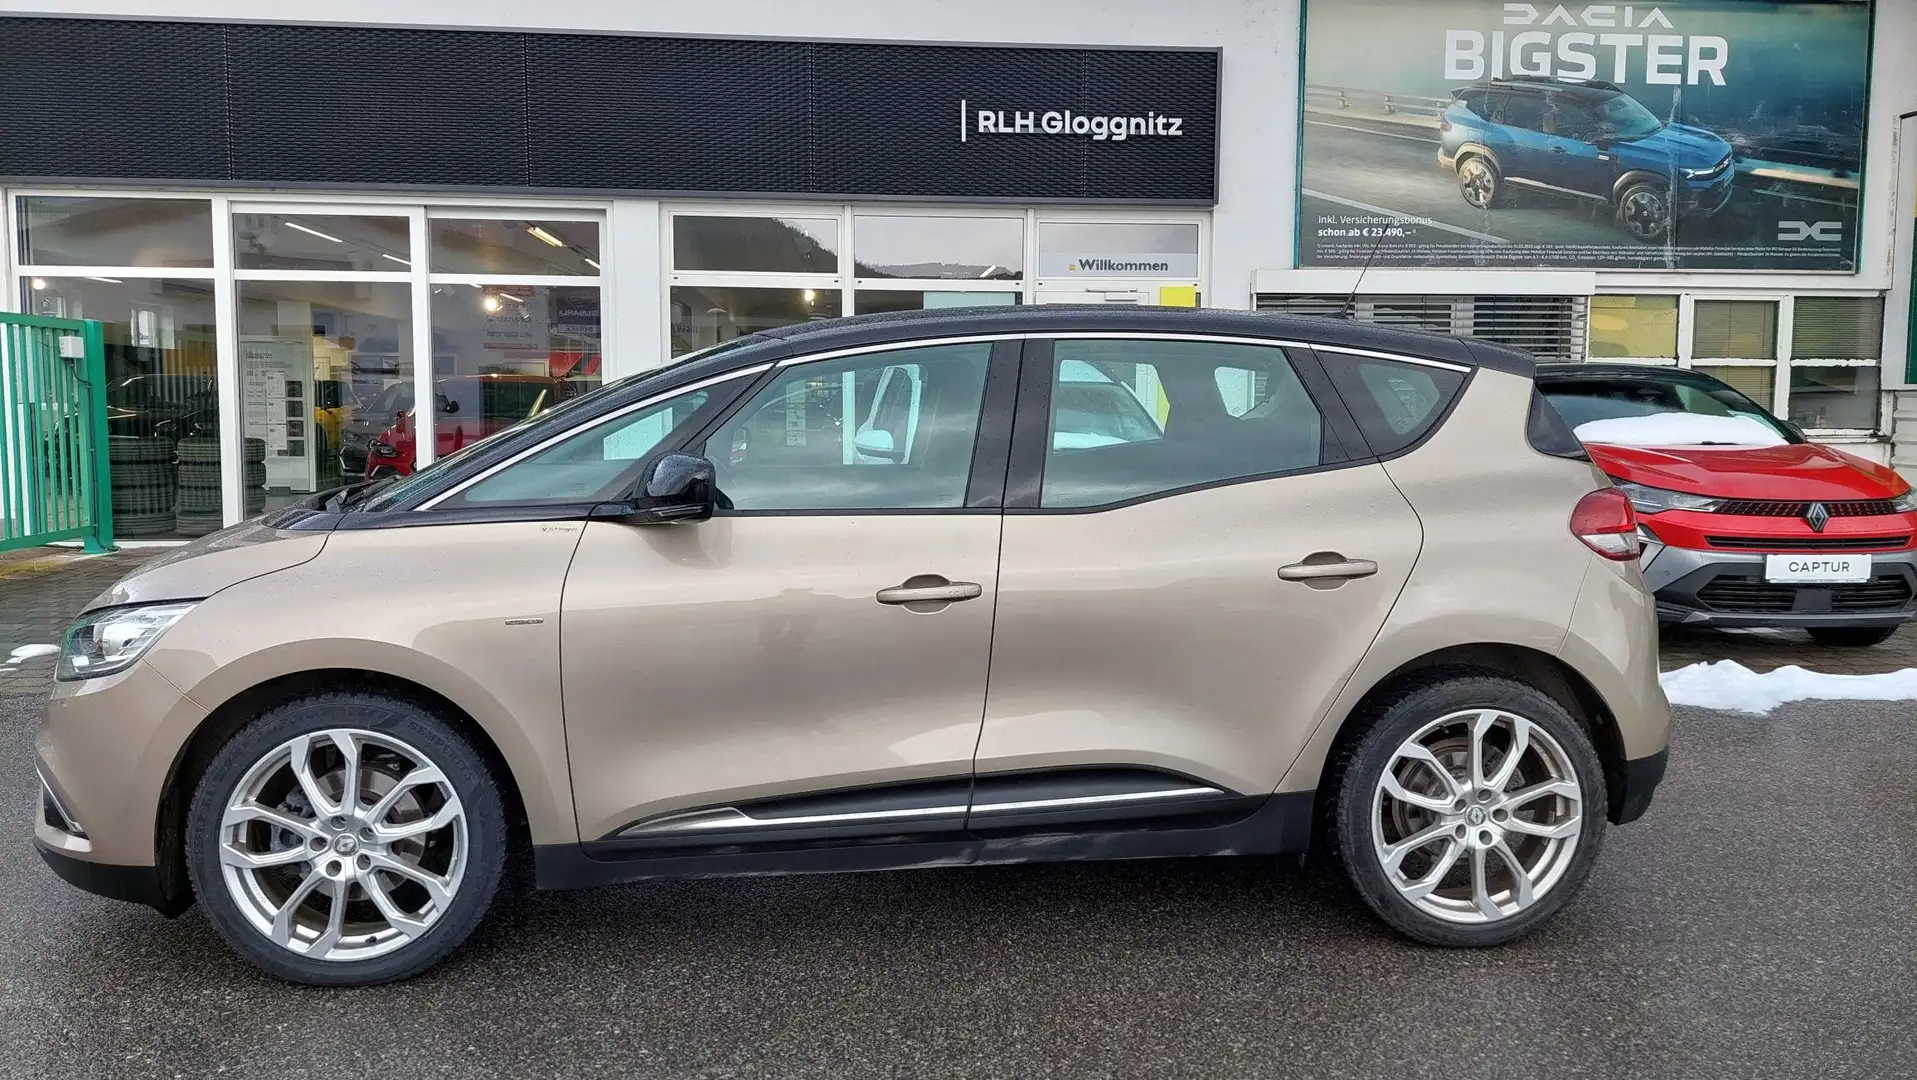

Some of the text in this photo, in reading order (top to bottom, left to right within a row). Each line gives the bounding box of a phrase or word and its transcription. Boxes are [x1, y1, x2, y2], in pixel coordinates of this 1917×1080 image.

[1503, 3, 1674, 28] DACIA
[1444, 30, 1728, 87] BIGSTER
[978, 110, 1183, 141] RLH Gloggnitz
[1318, 215, 1433, 226] inkl. Versicherungsbonus
[1318, 228, 1346, 237] schon
[1348, 228, 1361, 237] ab
[1362, 228, 1370, 237] €
[1079, 258, 1169, 271] Willkommen
[1788, 561, 1850, 573] CAPTUR
